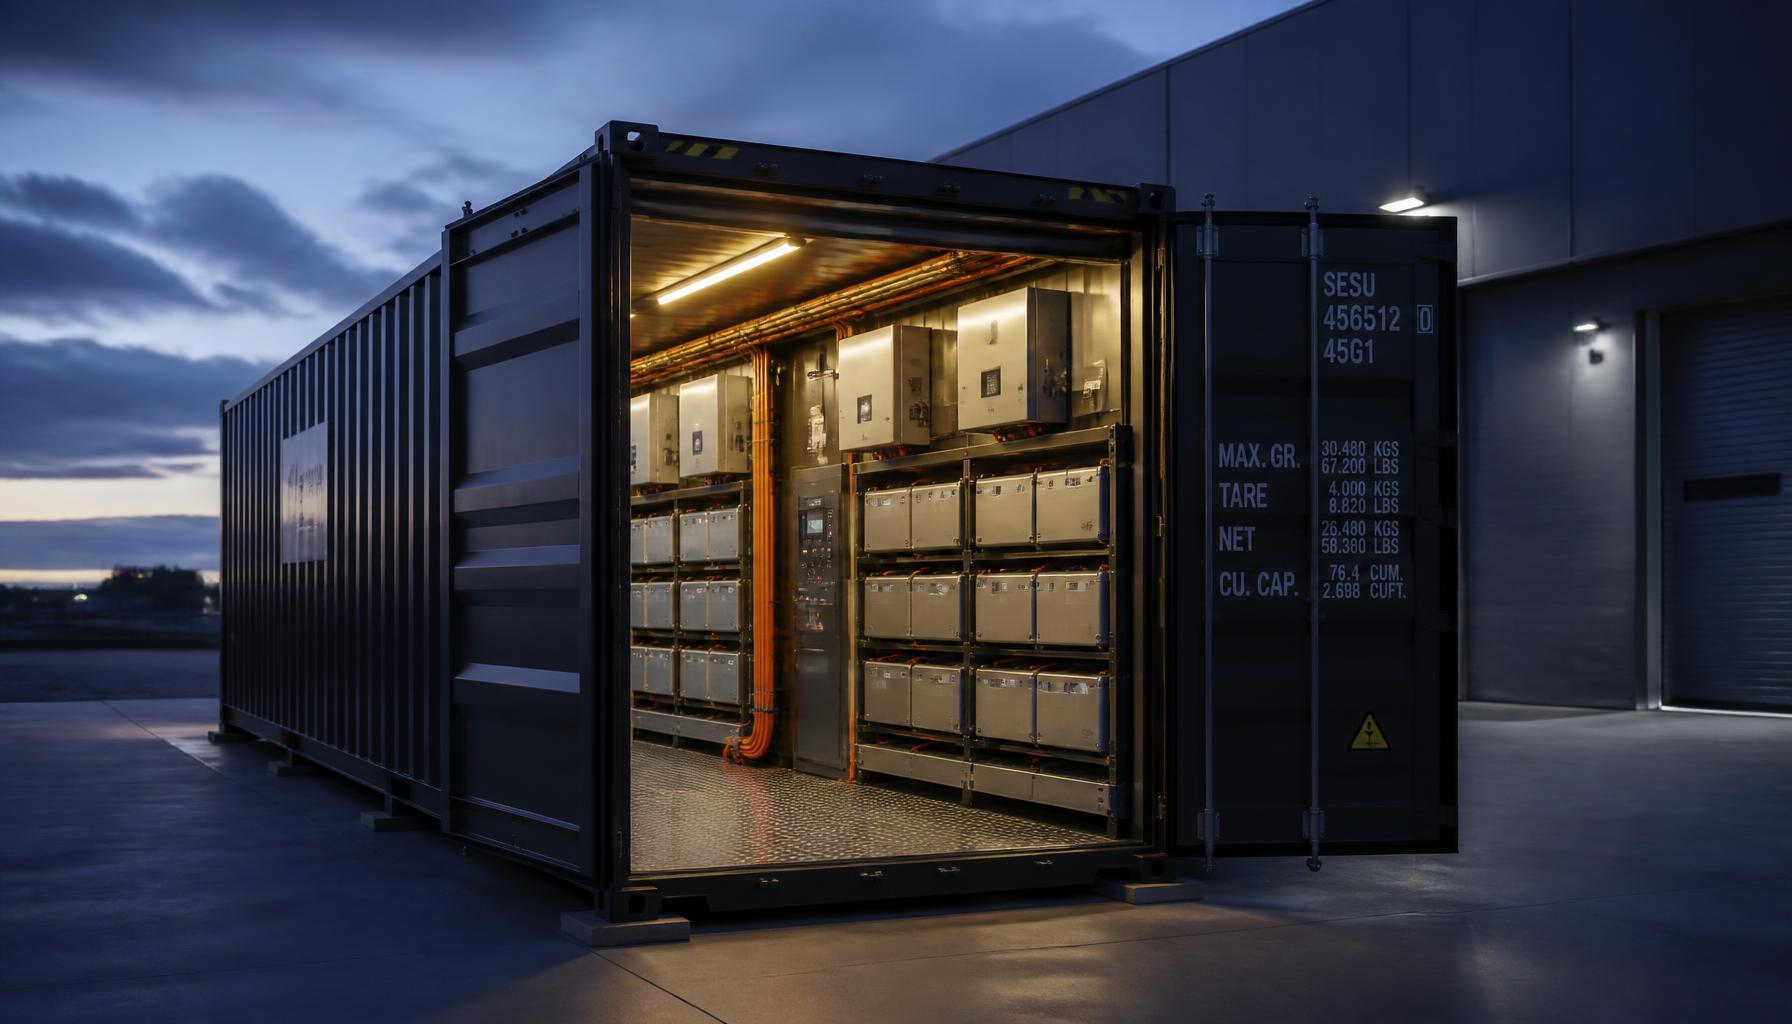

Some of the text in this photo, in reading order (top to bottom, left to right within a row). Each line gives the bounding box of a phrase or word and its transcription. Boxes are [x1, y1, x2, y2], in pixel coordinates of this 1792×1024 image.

[1323, 271, 1376, 297] SESU
[1323, 304, 1400, 331] 456512
[1323, 338, 1374, 363] 45G1
[1219, 442, 1300, 468] MAX. GR.
[1321, 440, 1399, 456] 30.480 KGS
[1321, 458, 1399, 474] 67.200 LBS
[1219, 482, 1268, 508] TARE
[1329, 480, 1399, 496] 4.000 KGS
[1329, 498, 1399, 513] 8.820 LBS
[1321, 520, 1399, 536] 26.480 KGS
[1219, 526, 1256, 551] NET
[1321, 538, 1399, 554] 58.380 LBS
[1330, 564, 1404, 581] 76.4 CUM.
[1219, 571, 1299, 596] CU. CAP.
[1370, 582, 1407, 599] CUFT.
